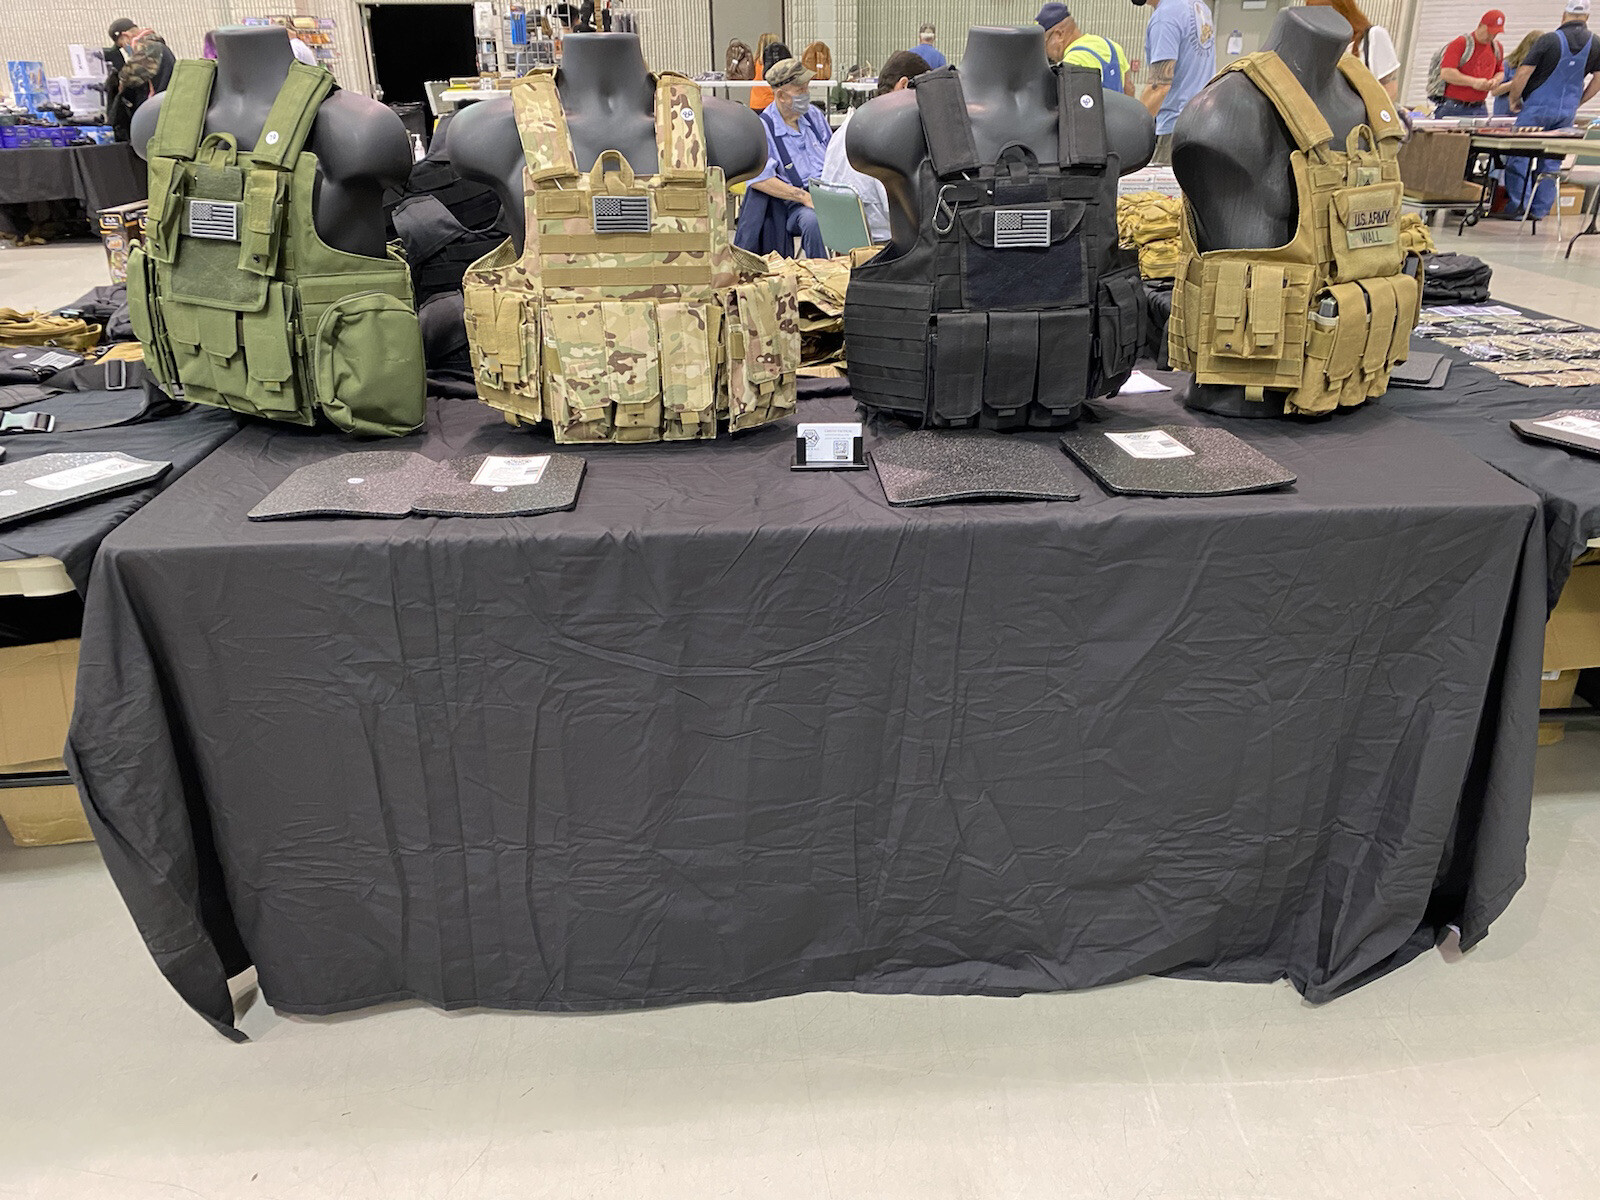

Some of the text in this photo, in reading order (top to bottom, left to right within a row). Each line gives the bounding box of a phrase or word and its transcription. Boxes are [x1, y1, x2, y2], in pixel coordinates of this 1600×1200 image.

[1354, 209, 1390, 226] U.S. ARMY
[1360, 230, 1383, 244] WALL
